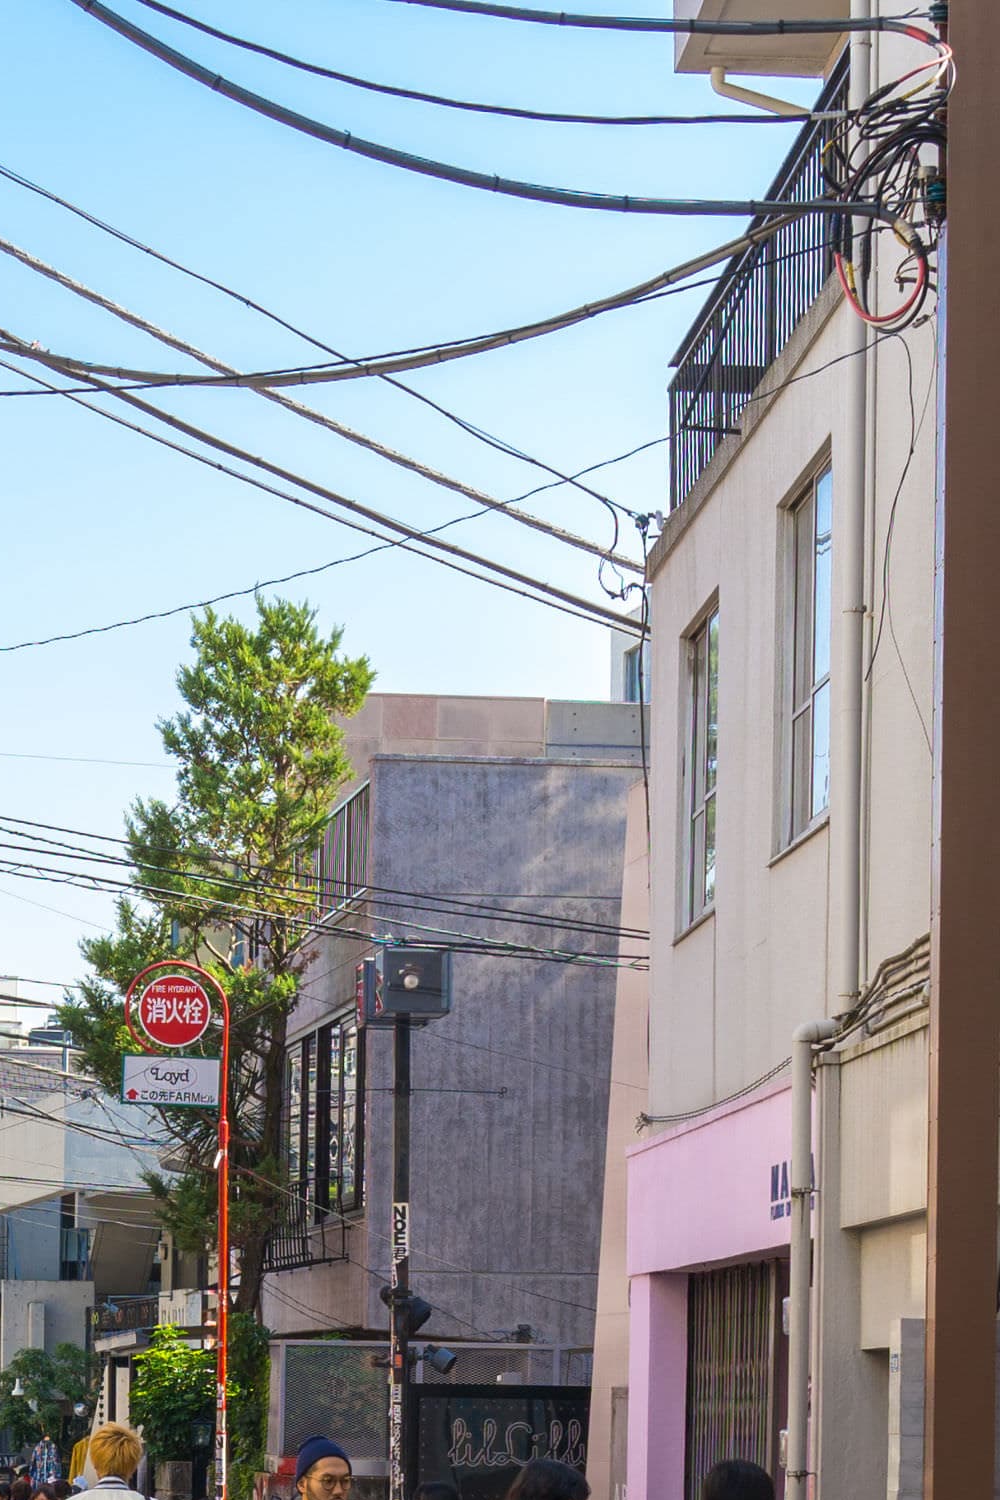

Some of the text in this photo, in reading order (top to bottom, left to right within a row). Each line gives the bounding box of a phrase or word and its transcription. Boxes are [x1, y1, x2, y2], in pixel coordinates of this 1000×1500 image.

[151, 985, 198, 994] FIRE HYDRANT
[146, 997, 204, 1025] 消火栓
[150, 1067, 190, 1086] Loyd
